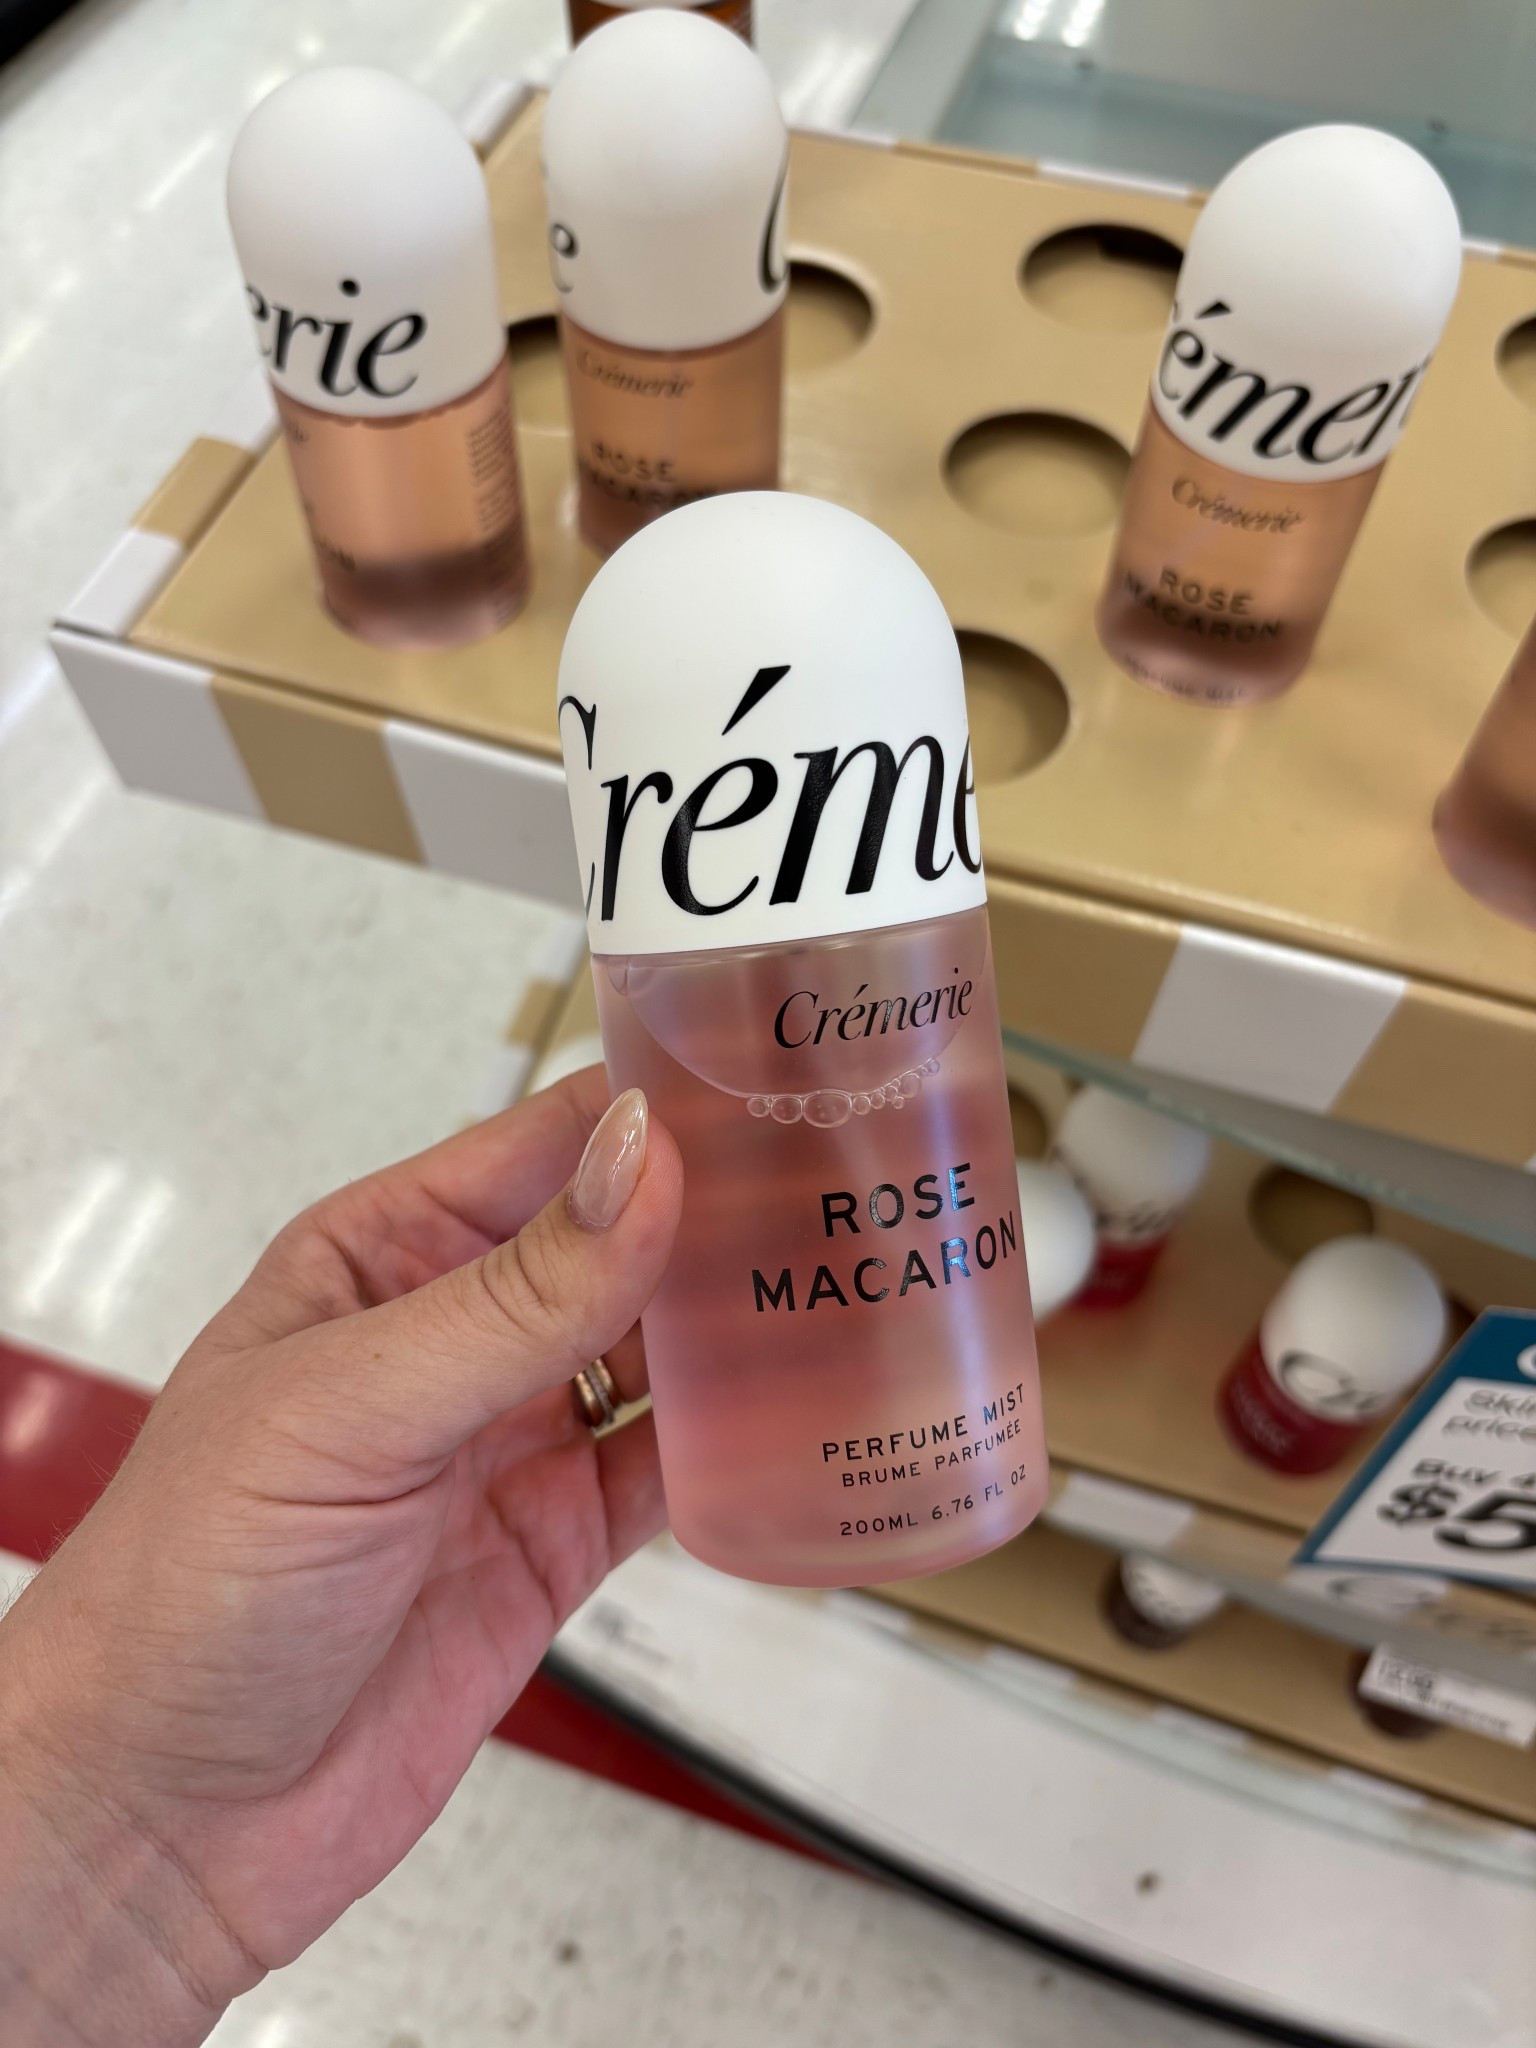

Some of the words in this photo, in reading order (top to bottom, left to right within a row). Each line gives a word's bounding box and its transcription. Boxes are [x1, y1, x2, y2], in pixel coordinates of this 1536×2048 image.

[1123, 570, 1284, 645] MACARON
[1159, 565, 1254, 616] ROSE
[773, 966, 973, 1049] Crémerie
[820, 1161, 977, 1238] ROSE
[751, 1210, 1018, 1313] MACARON
[822, 1414, 969, 1463] PERFUME
[982, 1382, 1024, 1426] MIST
[841, 1461, 922, 1488] BRUME
[934, 1417, 1022, 1471] PARFUMÉE
[839, 1511, 919, 1537] 200ML
[931, 1494, 975, 1521] 6.76
[984, 1481, 1004, 1502] FL
[1010, 1463, 1027, 1487] OZ
